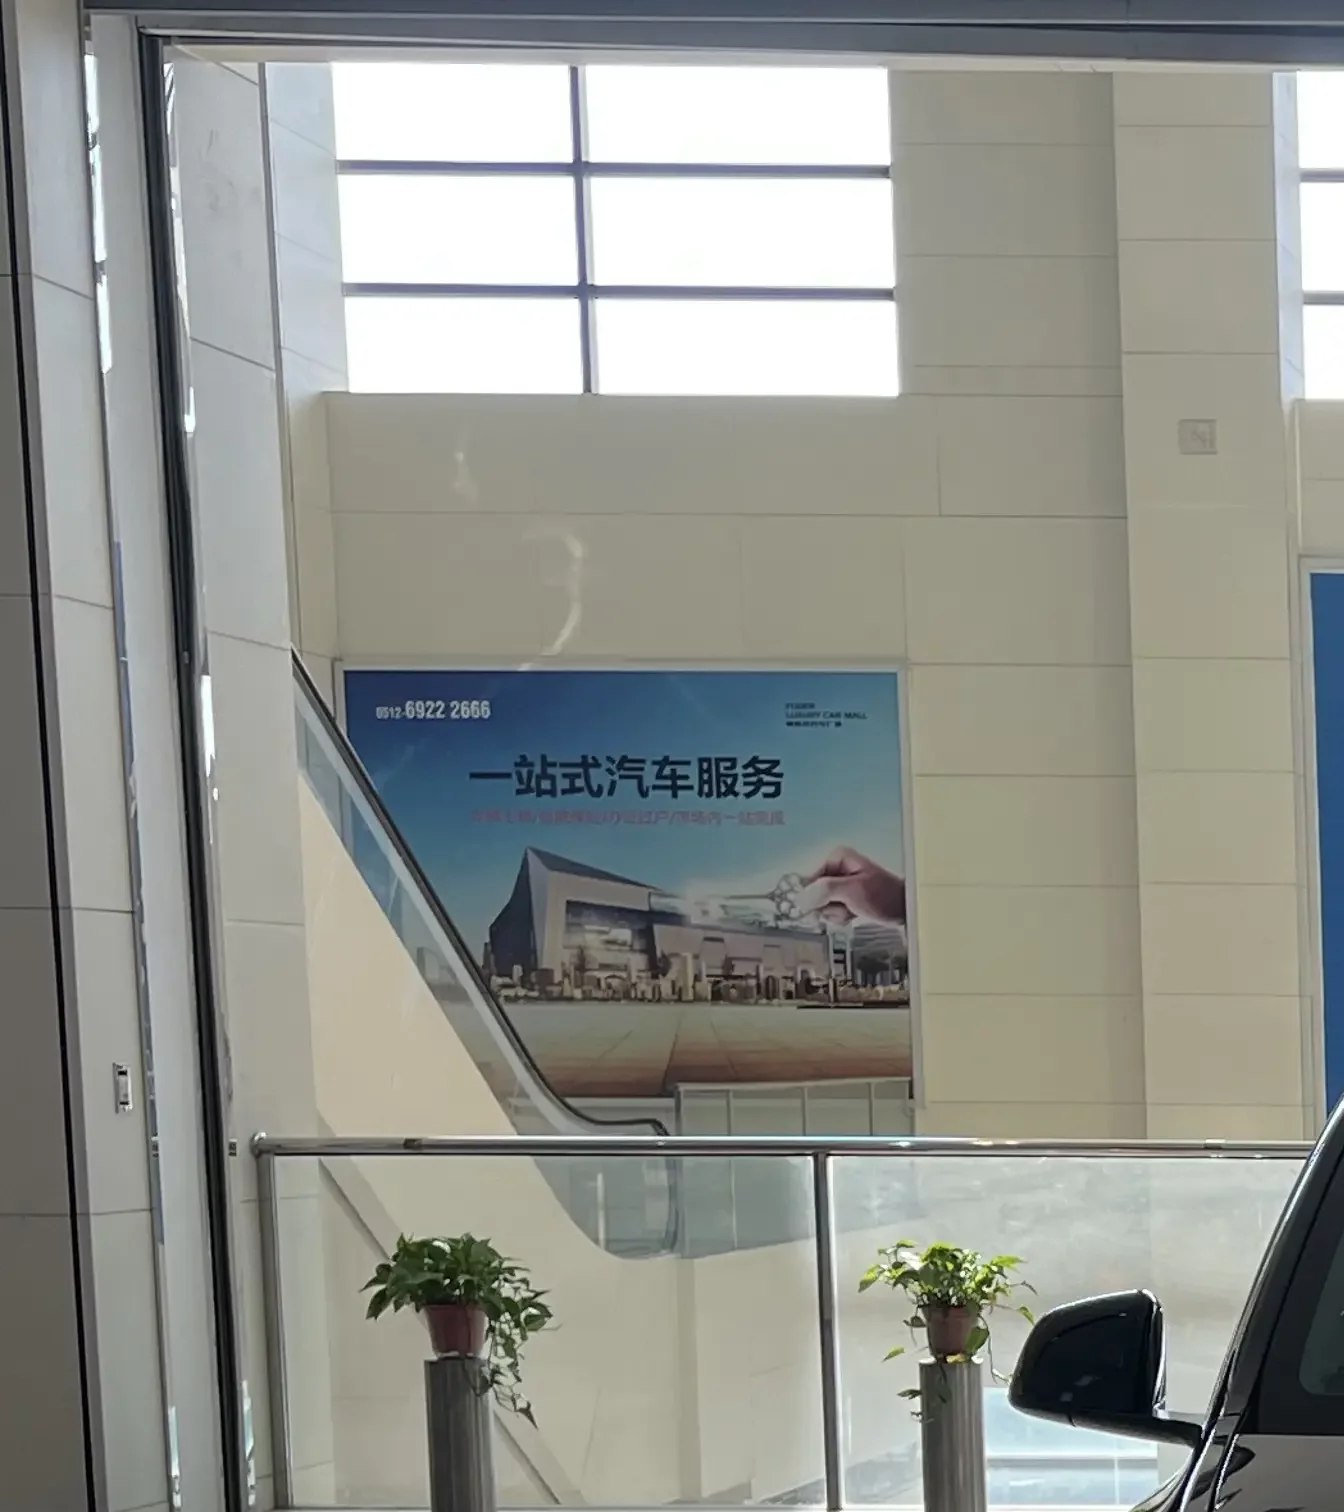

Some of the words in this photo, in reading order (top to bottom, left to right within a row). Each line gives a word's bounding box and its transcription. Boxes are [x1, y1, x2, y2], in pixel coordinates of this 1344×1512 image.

[449, 700, 491, 719] 2666
[469, 754, 784, 800] 一站式汽车服务
